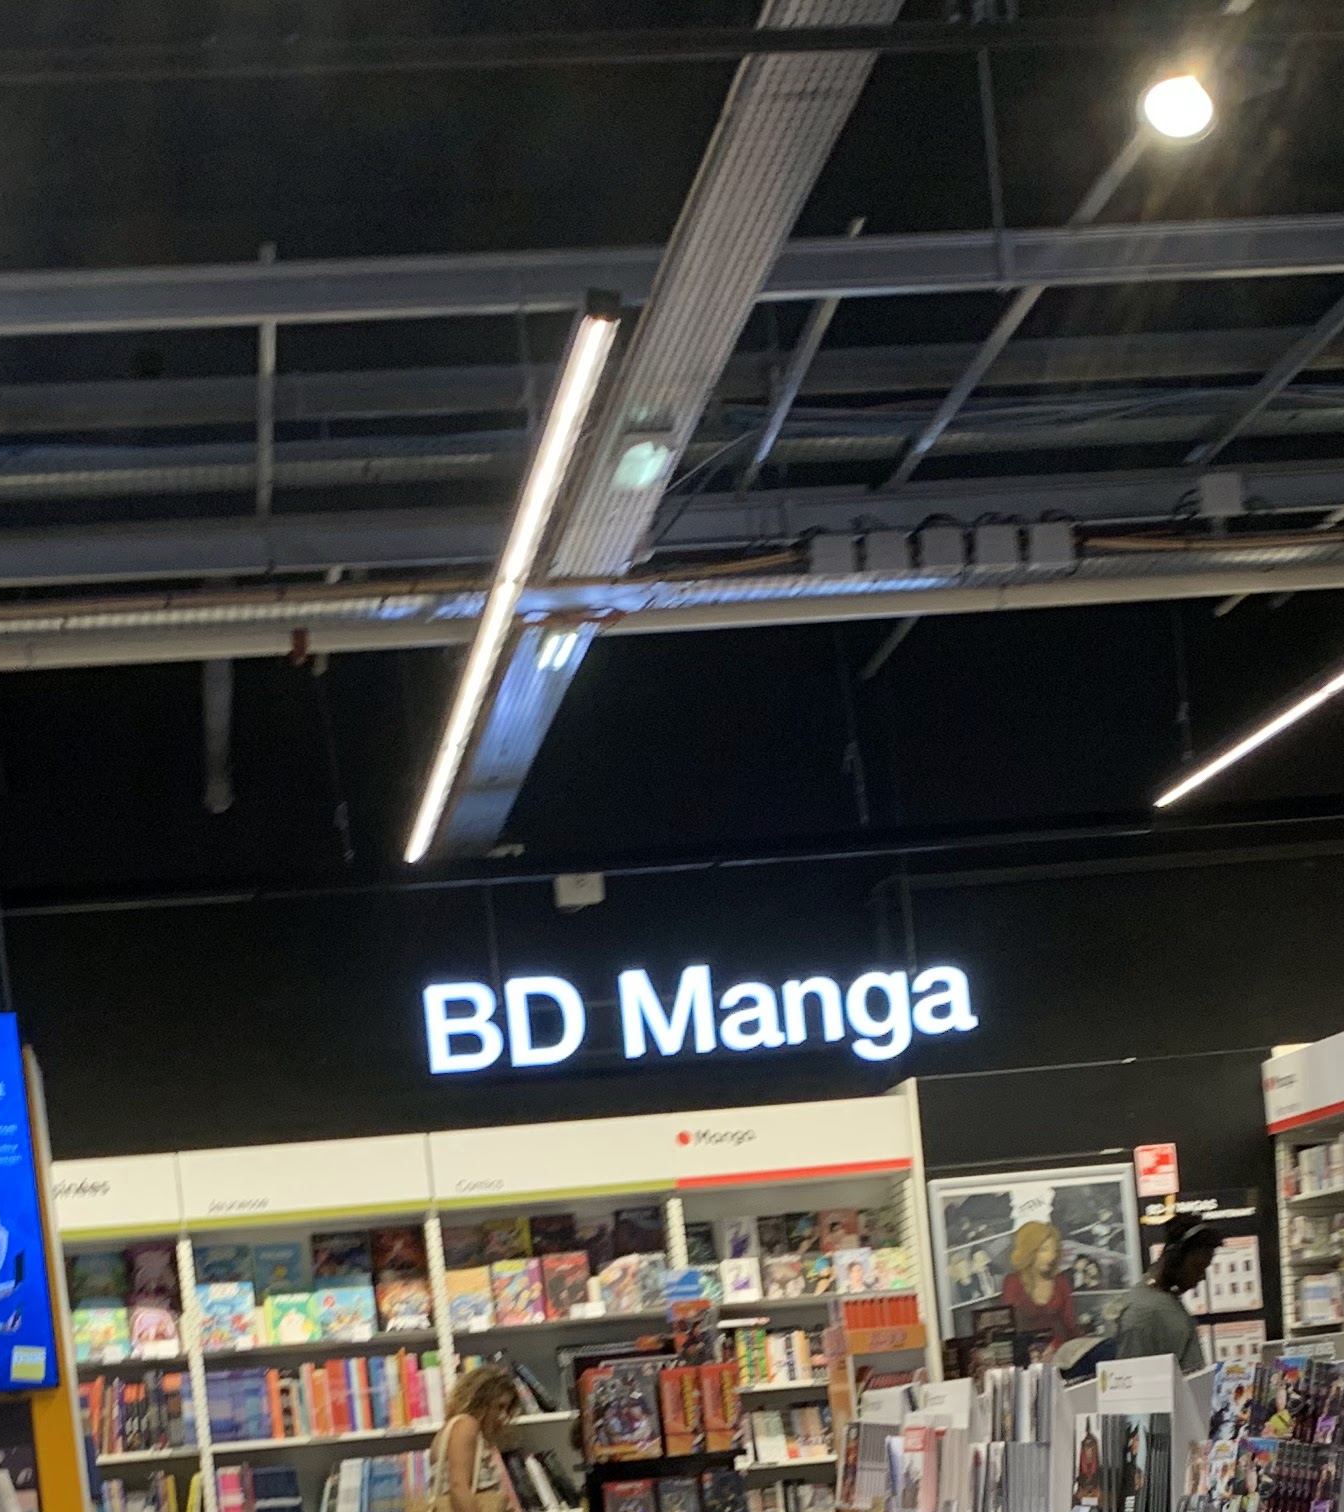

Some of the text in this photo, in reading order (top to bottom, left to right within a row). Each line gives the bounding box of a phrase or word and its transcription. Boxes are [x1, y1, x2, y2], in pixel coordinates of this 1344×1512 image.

[422, 964, 979, 1075] BD Manga
[693, 1128, 757, 1147] Manga
